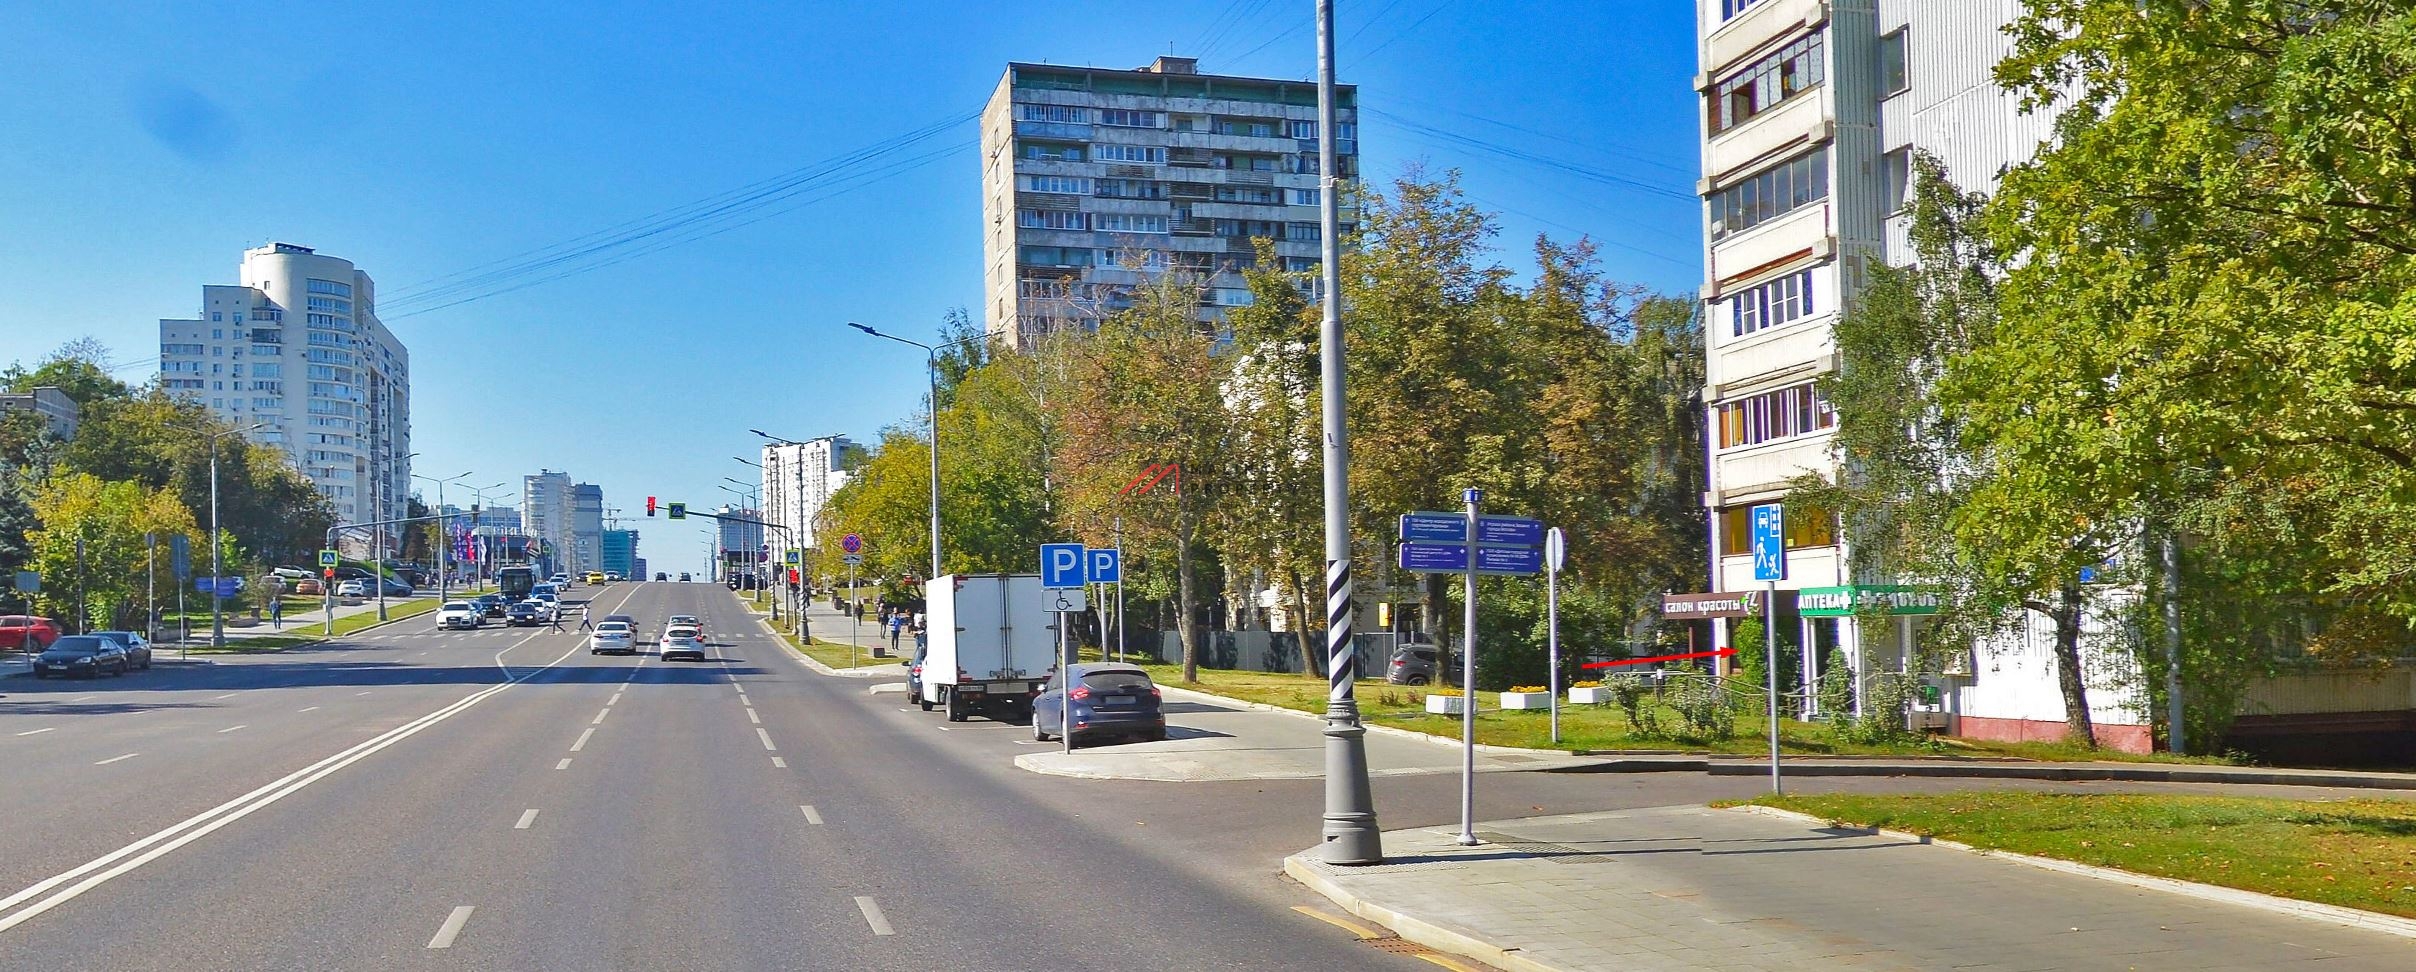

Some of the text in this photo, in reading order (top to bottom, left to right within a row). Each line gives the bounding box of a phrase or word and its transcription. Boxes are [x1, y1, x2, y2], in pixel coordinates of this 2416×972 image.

[1053, 548, 1077, 583] P
[1095, 553, 1114, 579] P
[1665, 599, 1741, 616] салон красоты
[1798, 593, 1840, 610] АПТЕКА
